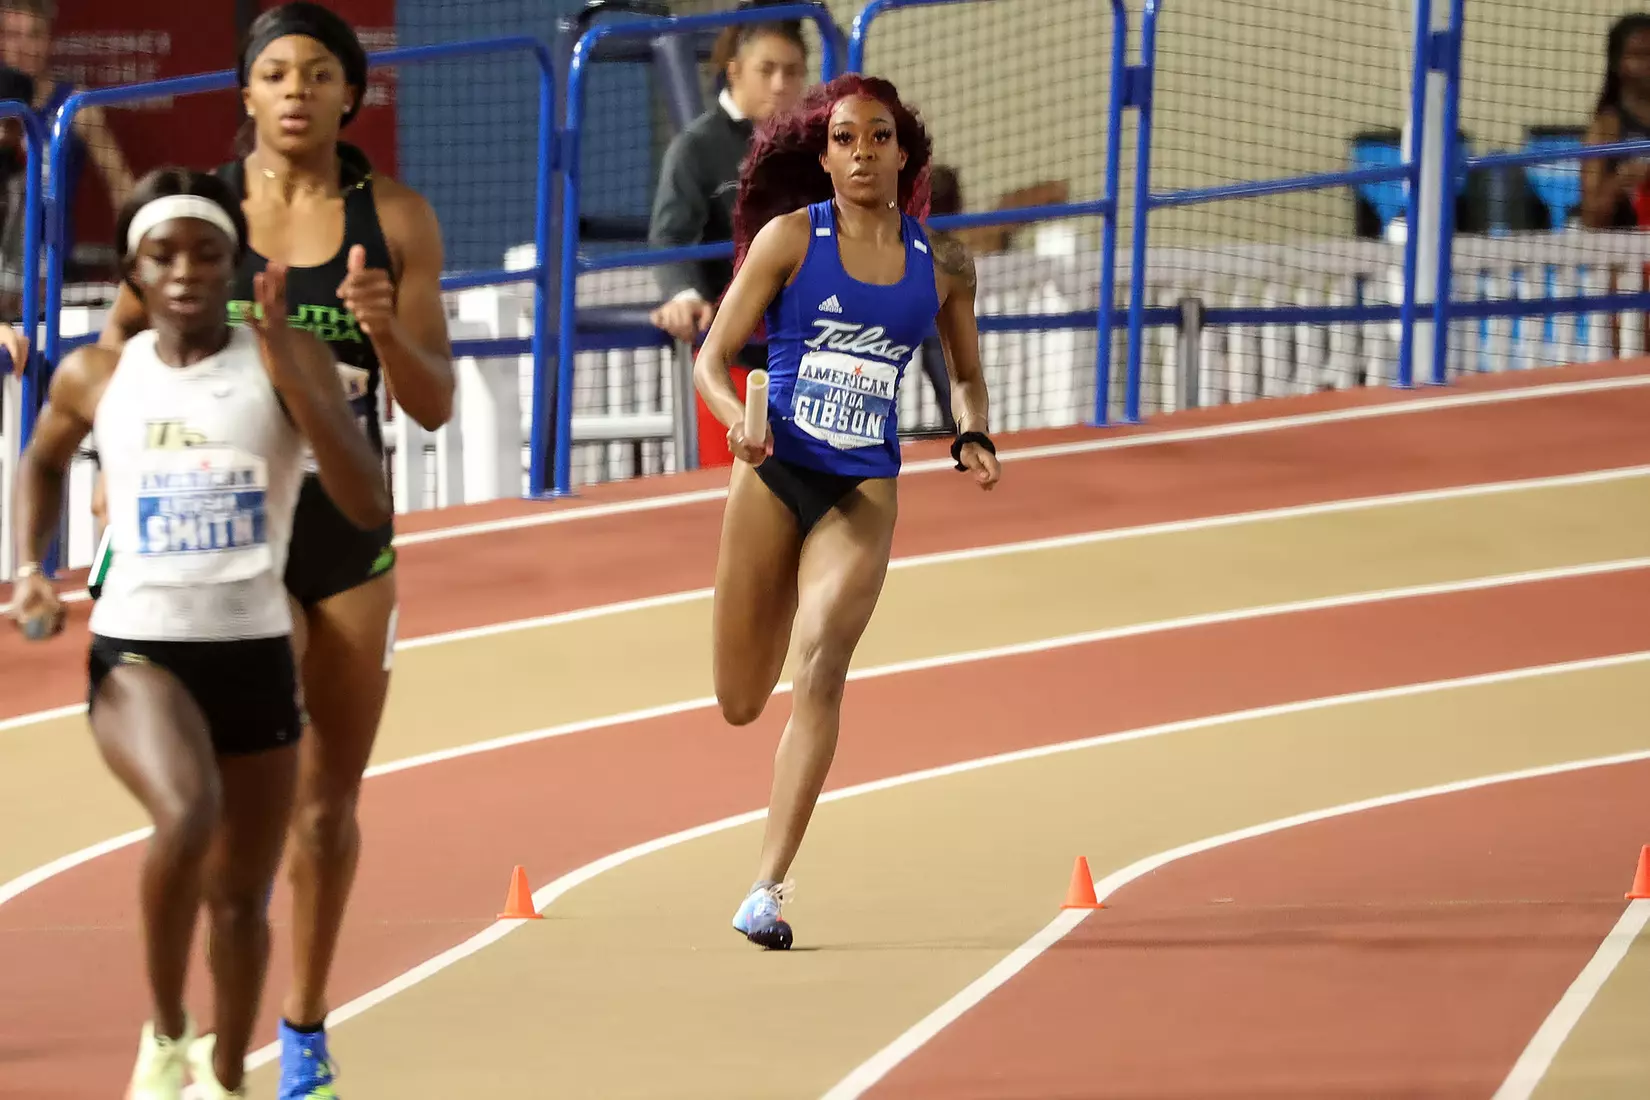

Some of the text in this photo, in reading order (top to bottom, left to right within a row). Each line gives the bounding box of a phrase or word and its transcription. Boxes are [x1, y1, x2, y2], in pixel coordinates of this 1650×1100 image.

[804, 318, 911, 361] Tulsa
[803, 365, 889, 396] AMERICAN
[824, 387, 864, 409] JAYDA
[795, 396, 883, 438] GIBSON
[146, 512, 254, 551] SMITH
